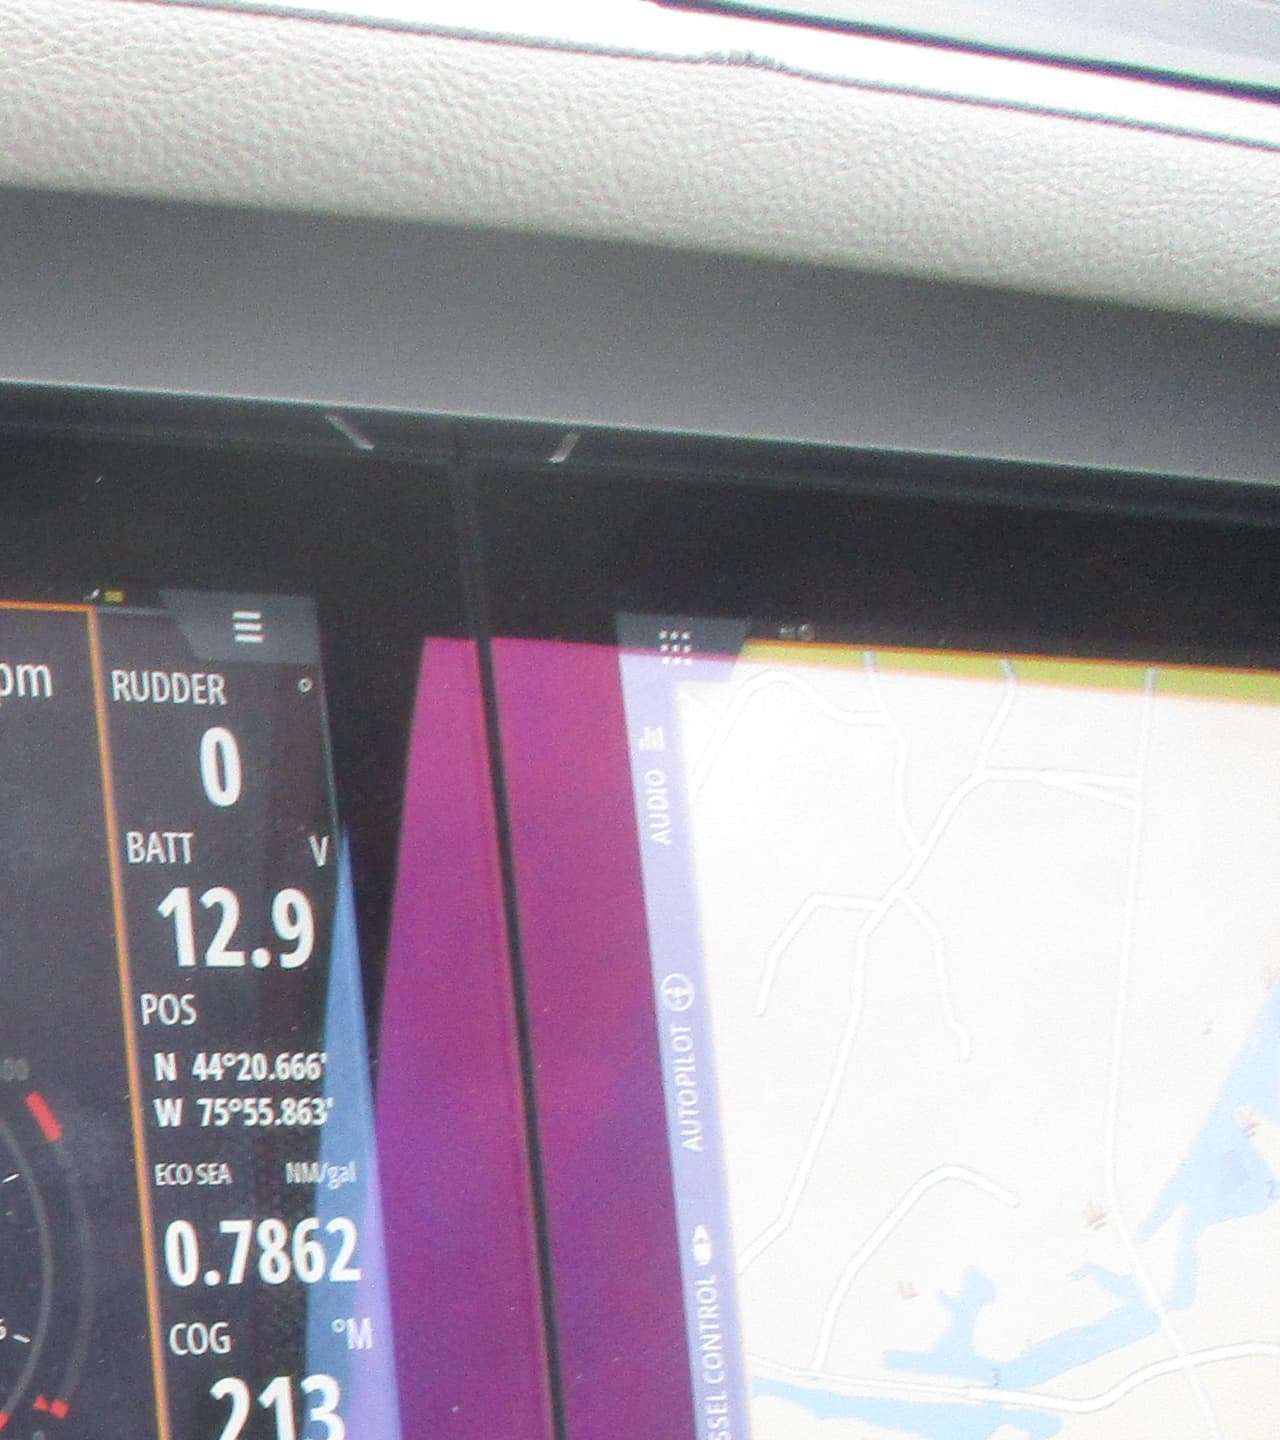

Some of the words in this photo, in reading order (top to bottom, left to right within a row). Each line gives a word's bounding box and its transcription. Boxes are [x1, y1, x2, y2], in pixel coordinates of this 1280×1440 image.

[112, 669, 227, 705] RUDDER
[199, 726, 241, 807] 0
[644, 768, 672, 846] AUDIO
[126, 831, 194, 865] BATT
[308, 835, 329, 867] V
[157, 886, 316, 969] 12.9
[140, 993, 197, 1026] POS
[154, 1053, 177, 1082] N
[671, 1024, 702, 1153] AUTOPILOT
[154, 1099, 183, 1127] W
[155, 1162, 193, 1187] ECO
[197, 1161, 232, 1186] SEA
[286, 1160, 357, 1192] NM/gal
[163, 1217, 362, 1288] 0.7862
[169, 1320, 232, 1356] COG
[696, 1275, 724, 1387] CONTROL
